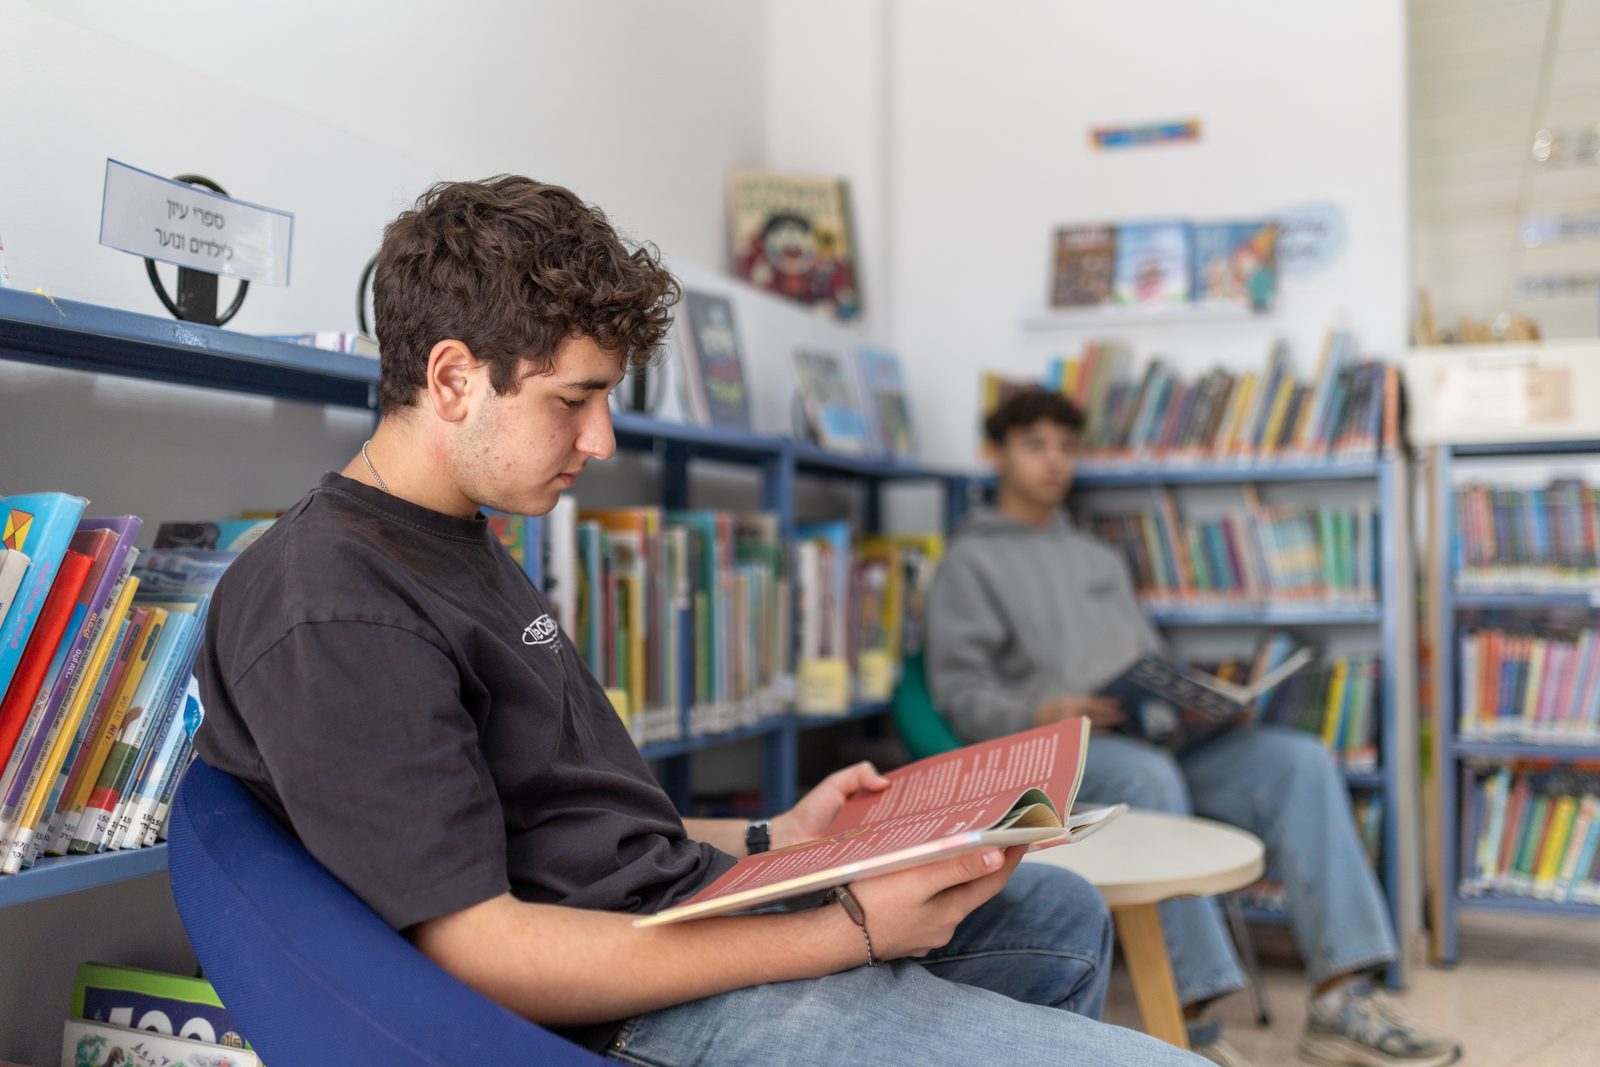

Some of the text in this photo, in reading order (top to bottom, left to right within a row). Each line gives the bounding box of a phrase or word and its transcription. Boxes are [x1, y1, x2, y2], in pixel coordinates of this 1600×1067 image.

[166, 199, 225, 230] ספרי עיון
[154, 227, 234, 261] לילדים ונוער
[63, 662, 75, 678] עברי
